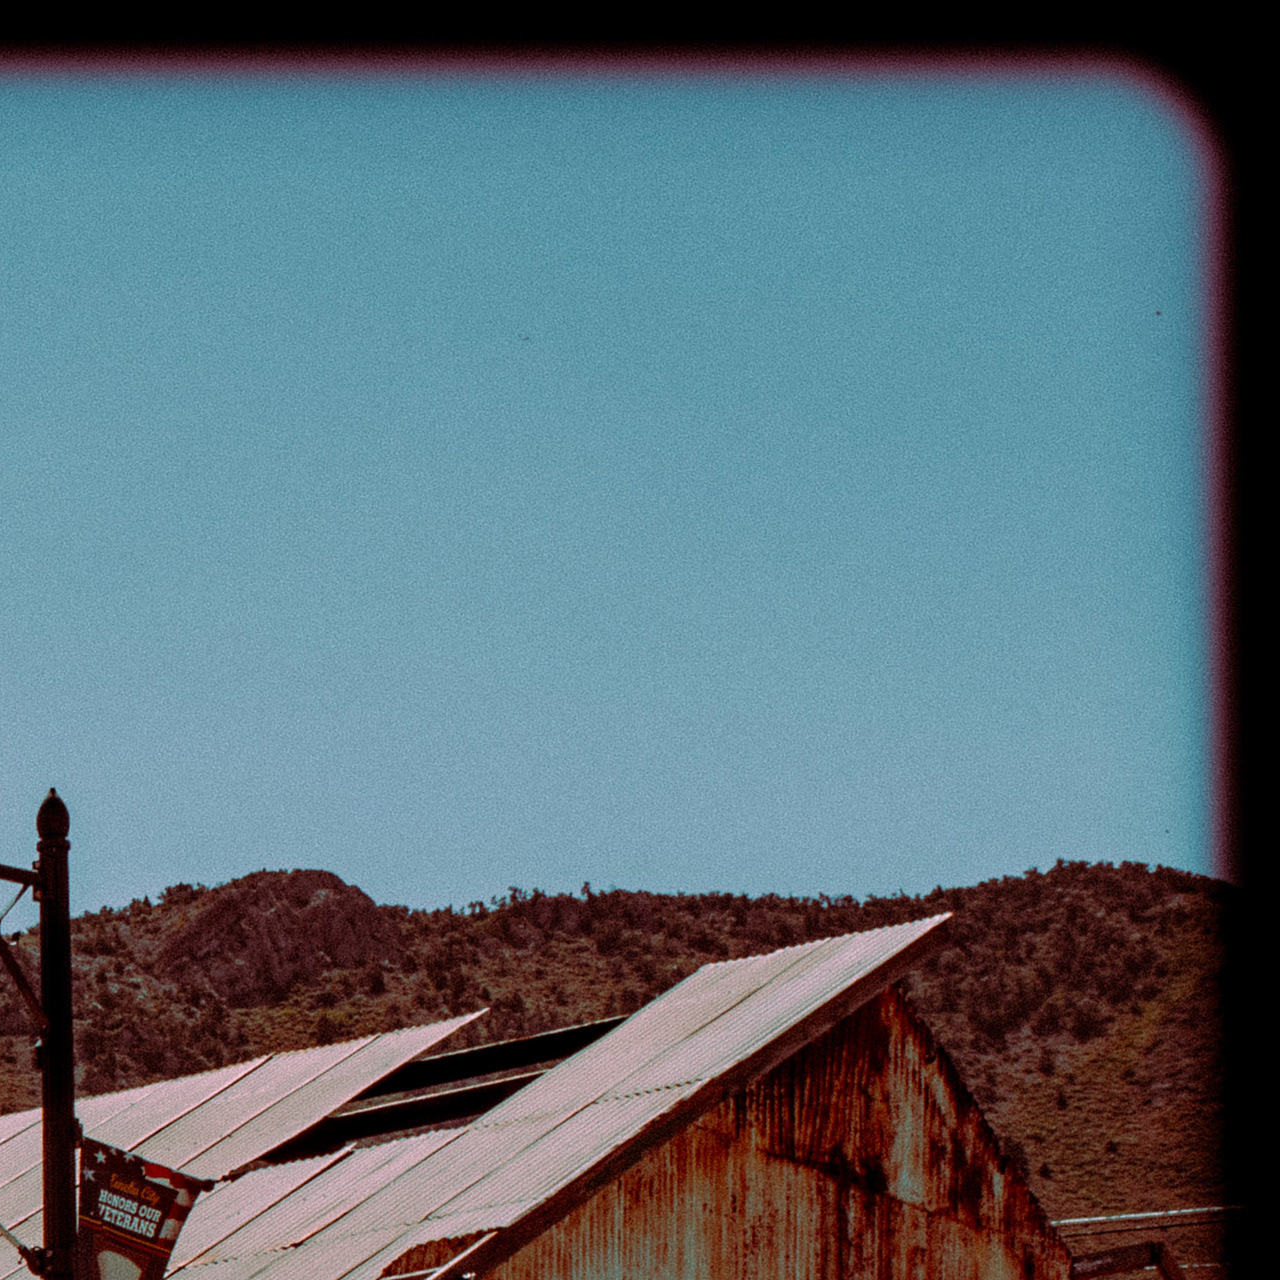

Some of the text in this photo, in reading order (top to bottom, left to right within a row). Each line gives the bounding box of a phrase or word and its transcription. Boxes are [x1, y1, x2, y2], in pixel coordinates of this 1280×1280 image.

[98, 1188, 162, 1223] HONORS OUR
[141, 1186, 160, 1205] City
[98, 1203, 157, 1238] VETERANS
